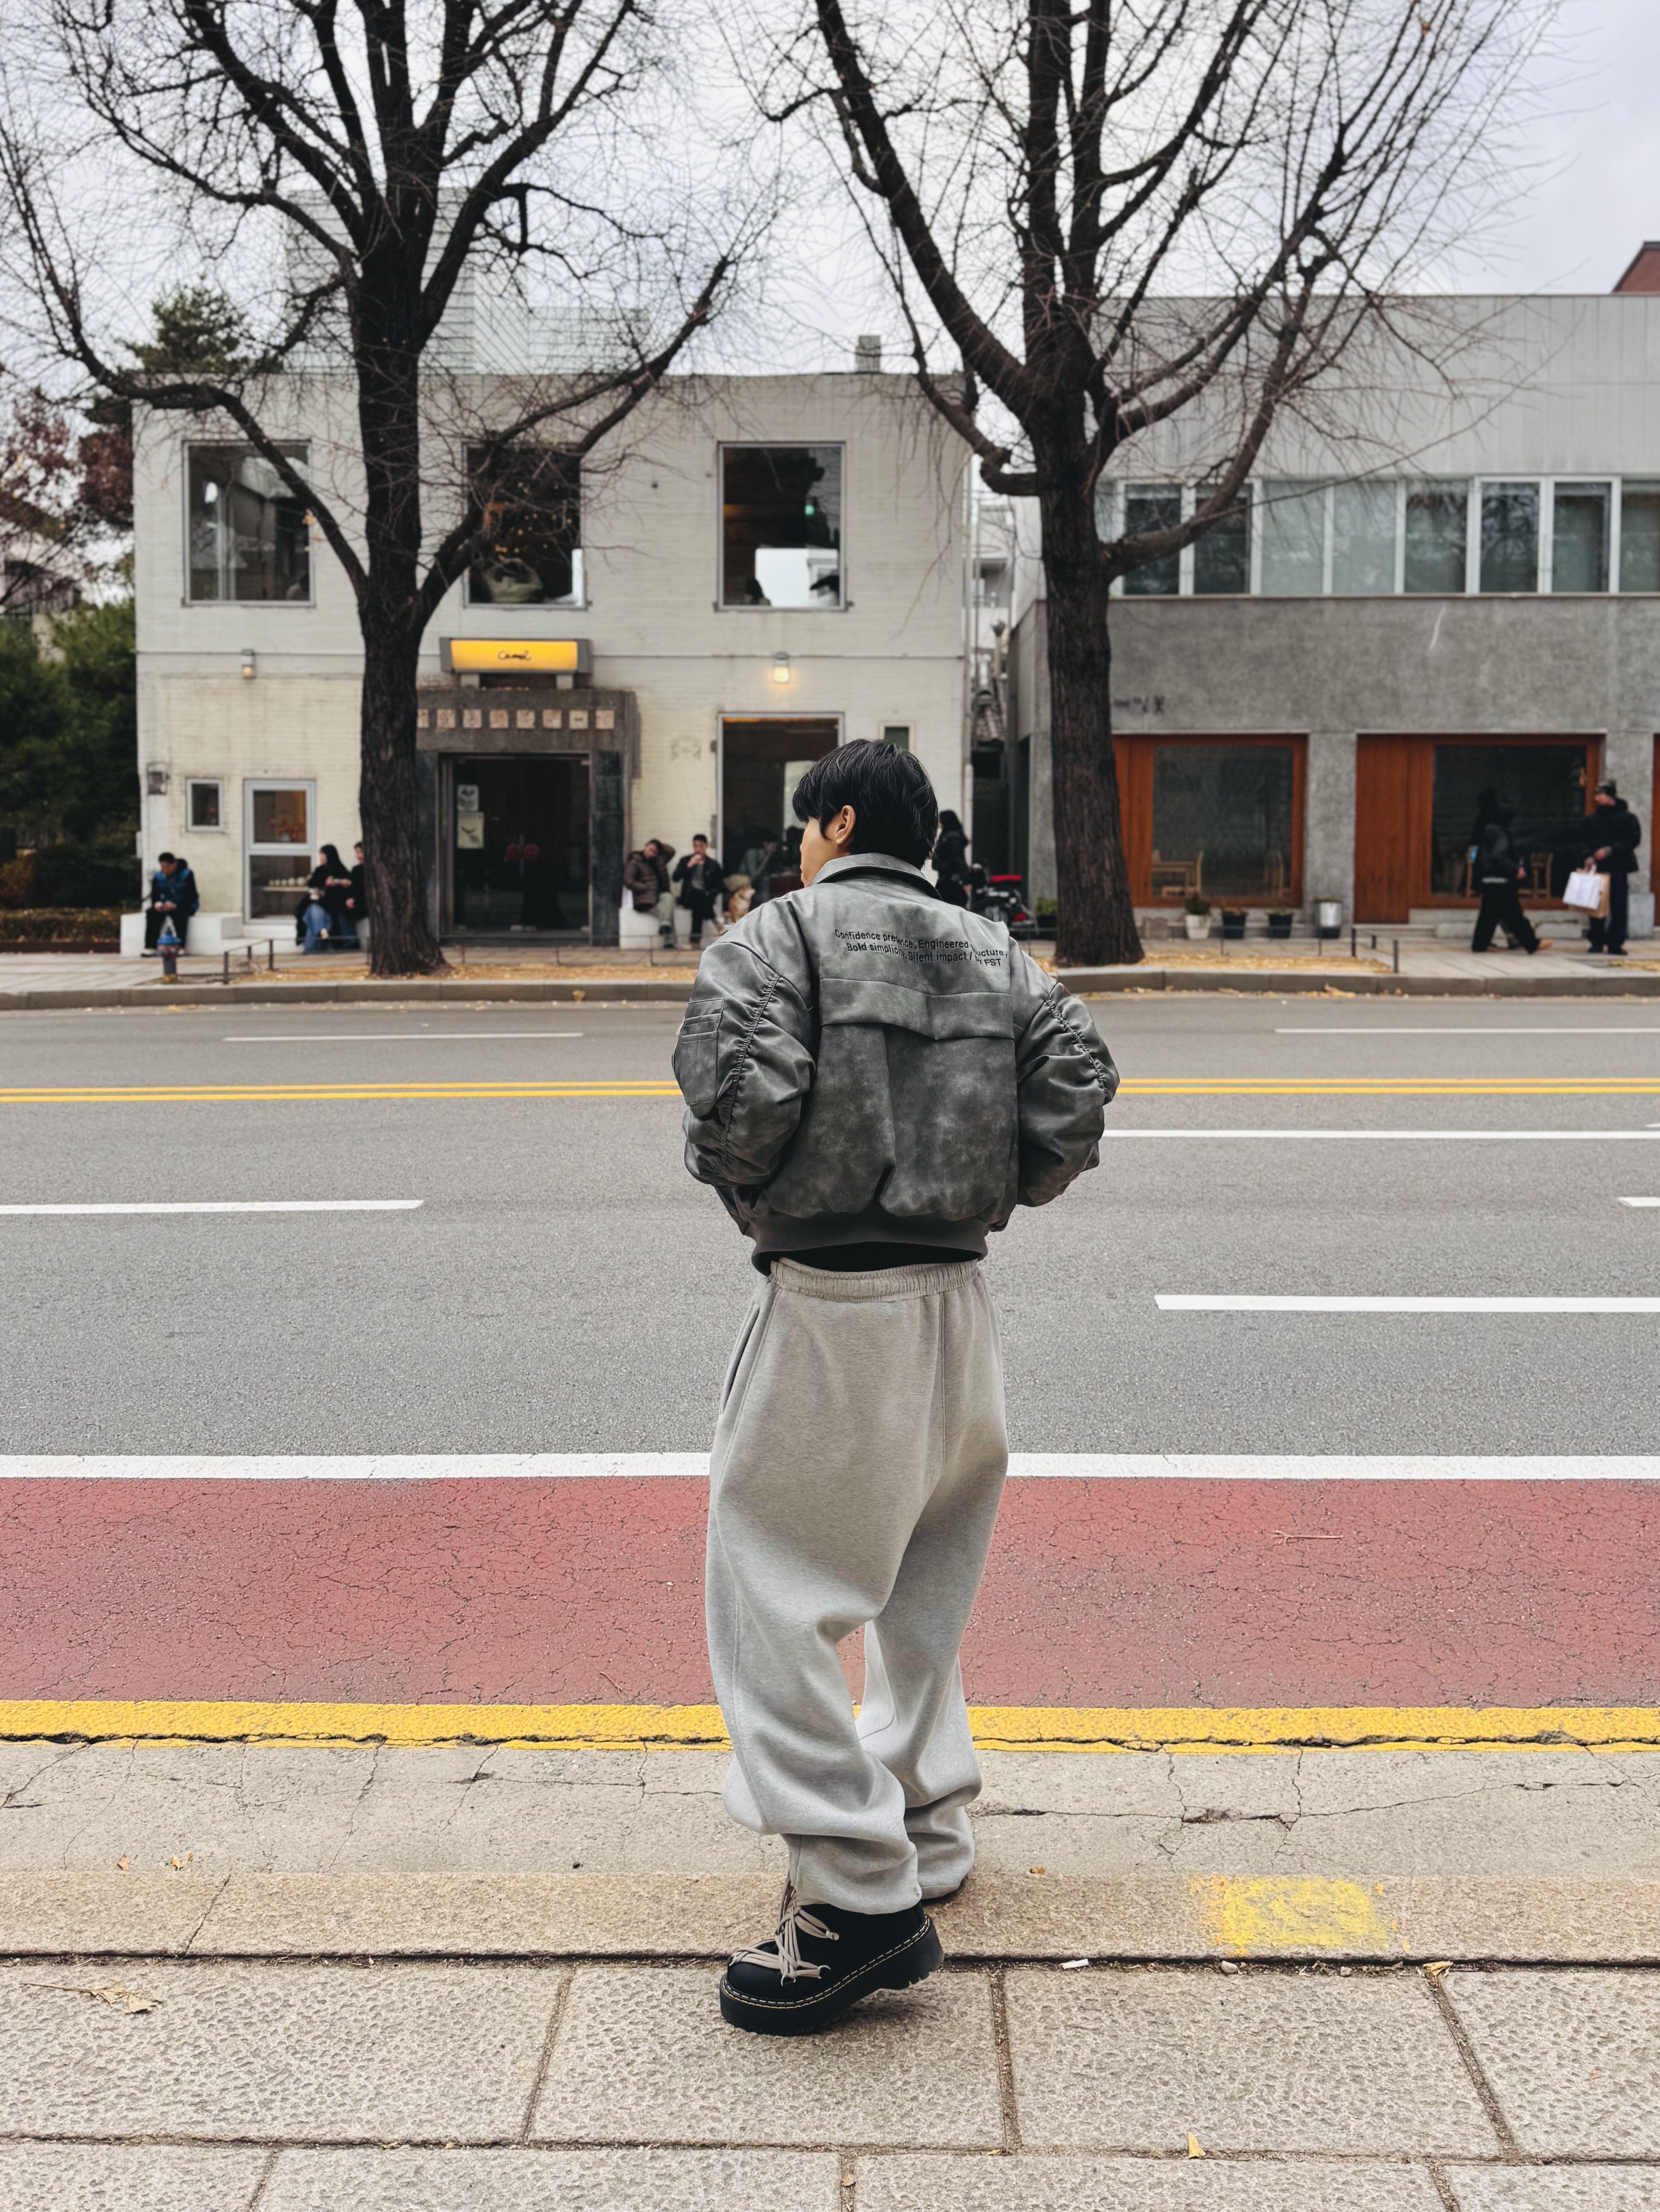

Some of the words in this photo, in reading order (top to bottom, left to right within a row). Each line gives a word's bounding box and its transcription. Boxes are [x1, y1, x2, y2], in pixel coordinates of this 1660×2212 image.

[835, 929, 881, 940] Confidence
[918, 938, 969, 950] Engineered
[970, 944, 1008, 958] ucture,
[846, 942, 868, 952] Bold
[908, 951, 933, 963] Silent
[936, 951, 967, 963] impact
[984, 958, 1001, 967] FST
